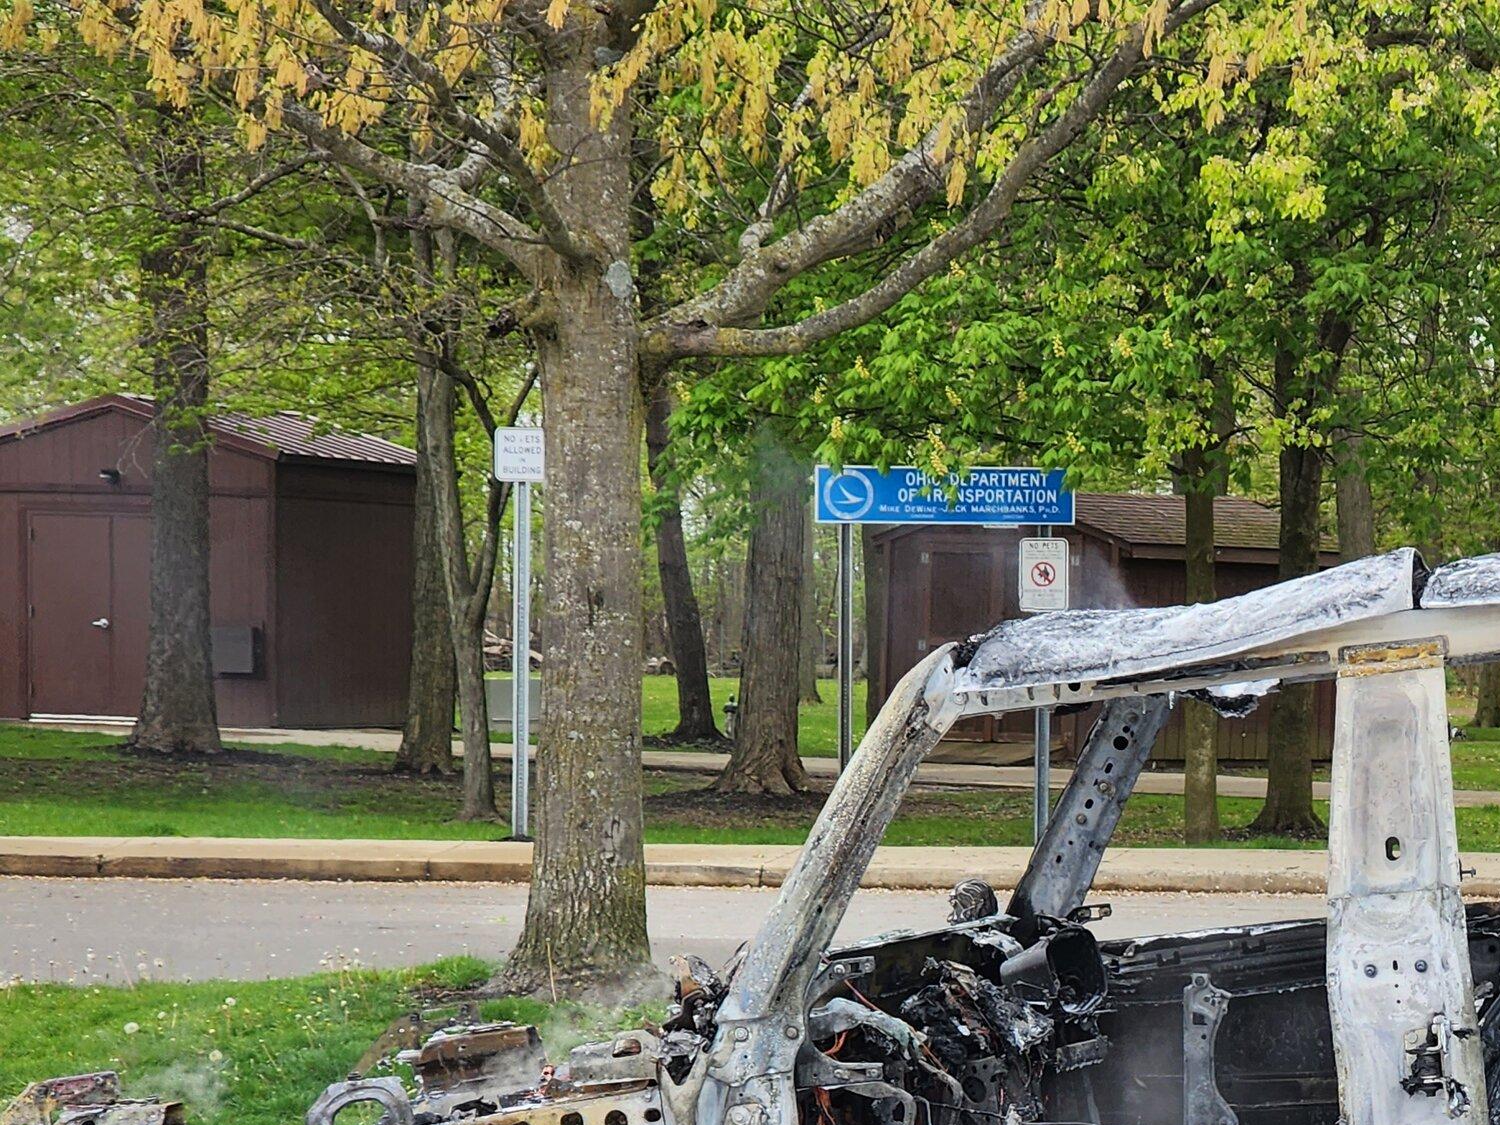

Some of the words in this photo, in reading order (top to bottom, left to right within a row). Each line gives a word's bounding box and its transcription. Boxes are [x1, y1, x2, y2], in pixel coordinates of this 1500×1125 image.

[503, 465, 541, 474] BUILDING
[897, 488, 918, 503] OF
[1029, 542, 1039, 550] NO
[1042, 542, 1059, 550] PETS
